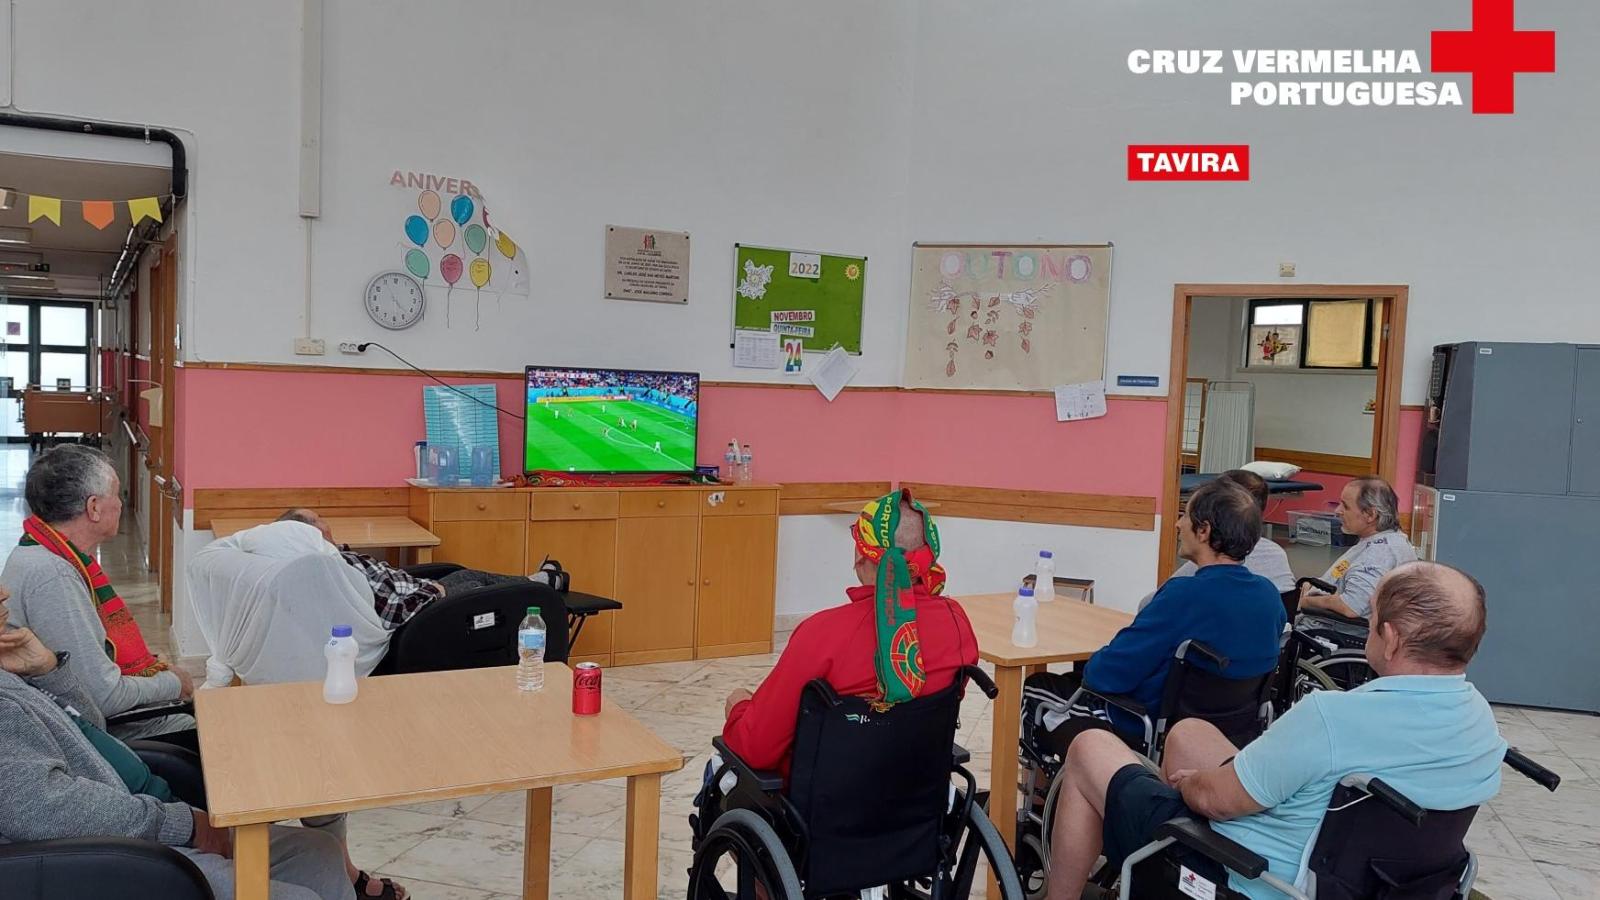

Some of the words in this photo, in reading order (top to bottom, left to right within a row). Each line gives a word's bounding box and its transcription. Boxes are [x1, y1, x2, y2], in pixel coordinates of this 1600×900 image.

[791, 262, 819, 276] 2022
[940, 250, 1092, 284] OUTONO
[774, 311, 813, 322] NOVEMBRO
[773, 323, 812, 337] QUINTA-FEIRA
[785, 342, 803, 372] 24
